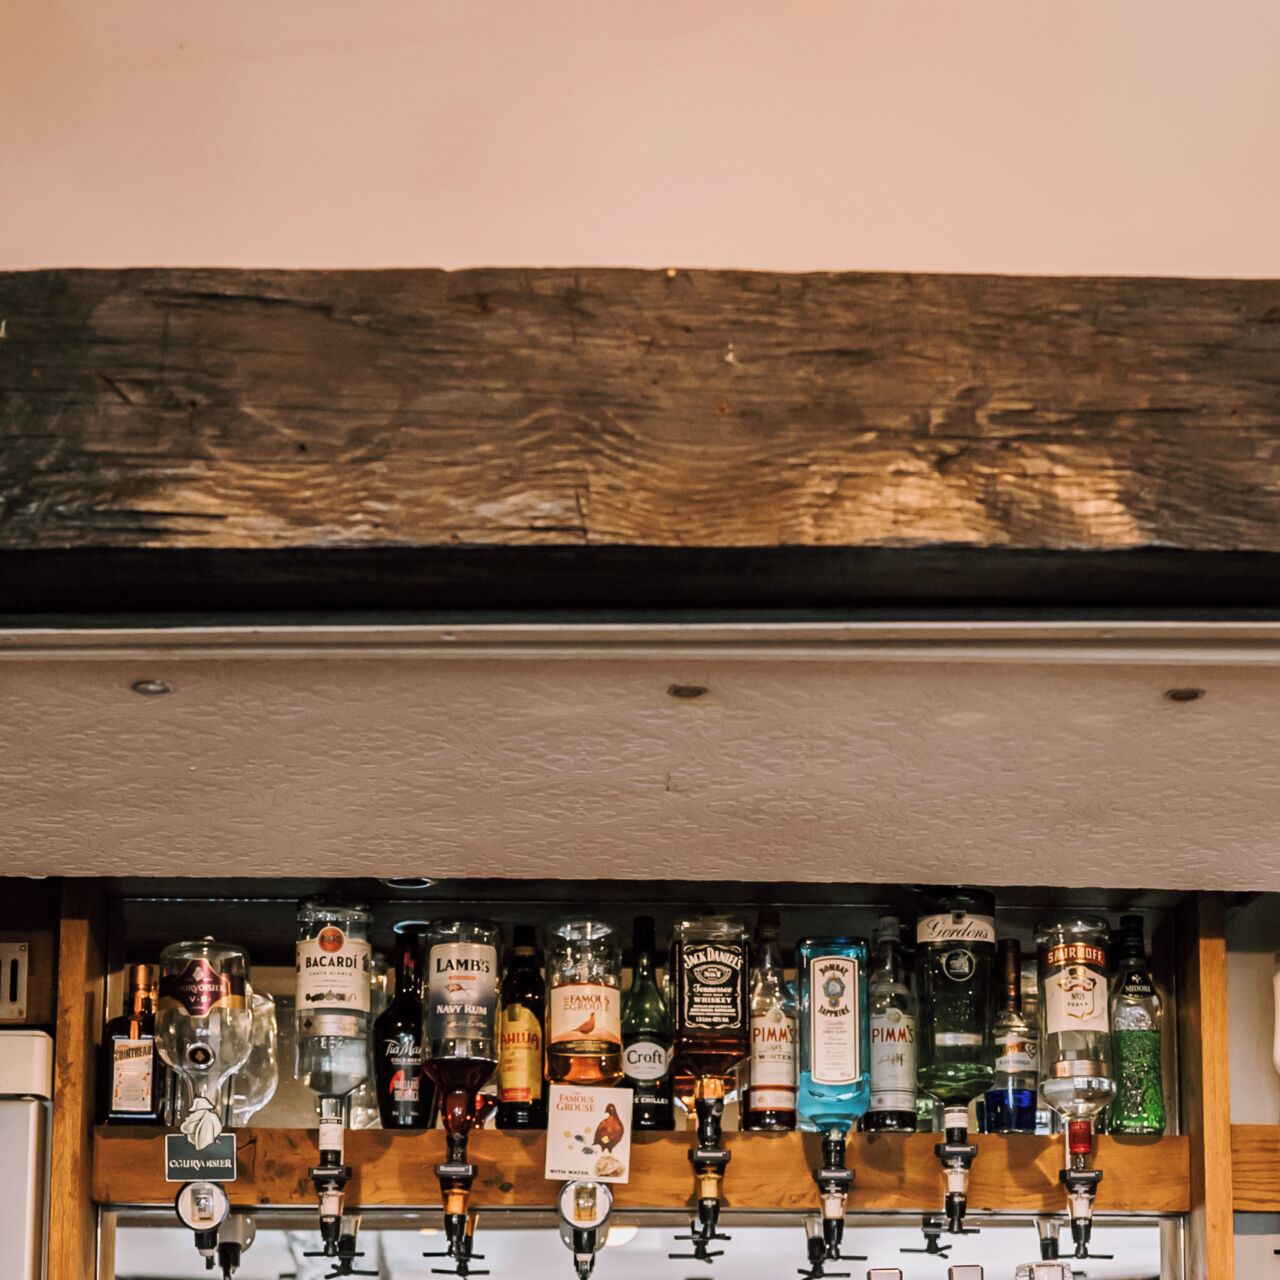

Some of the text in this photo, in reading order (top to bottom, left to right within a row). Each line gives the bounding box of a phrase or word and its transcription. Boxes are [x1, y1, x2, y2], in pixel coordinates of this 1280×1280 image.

[926, 919, 988, 941] Gordon's
[305, 955, 358, 968] BACARDÍ
[683, 947, 743, 970] JACK DANIEL'S
[436, 958, 490, 973] LAMB'S
[819, 964, 848, 977] BOMBAY
[693, 984, 732, 993] Tennessee
[436, 1004, 487, 1015] NAVY RUM
[752, 1024, 794, 1043] PIMM'S
[872, 1025, 914, 1044] PIMM'S
[627, 1049, 663, 1064] Croft
[559, 1094, 594, 1103] FAMOUS
[556, 1103, 596, 1112] GROUSE
[169, 1158, 232, 1170] COURVOISIER
